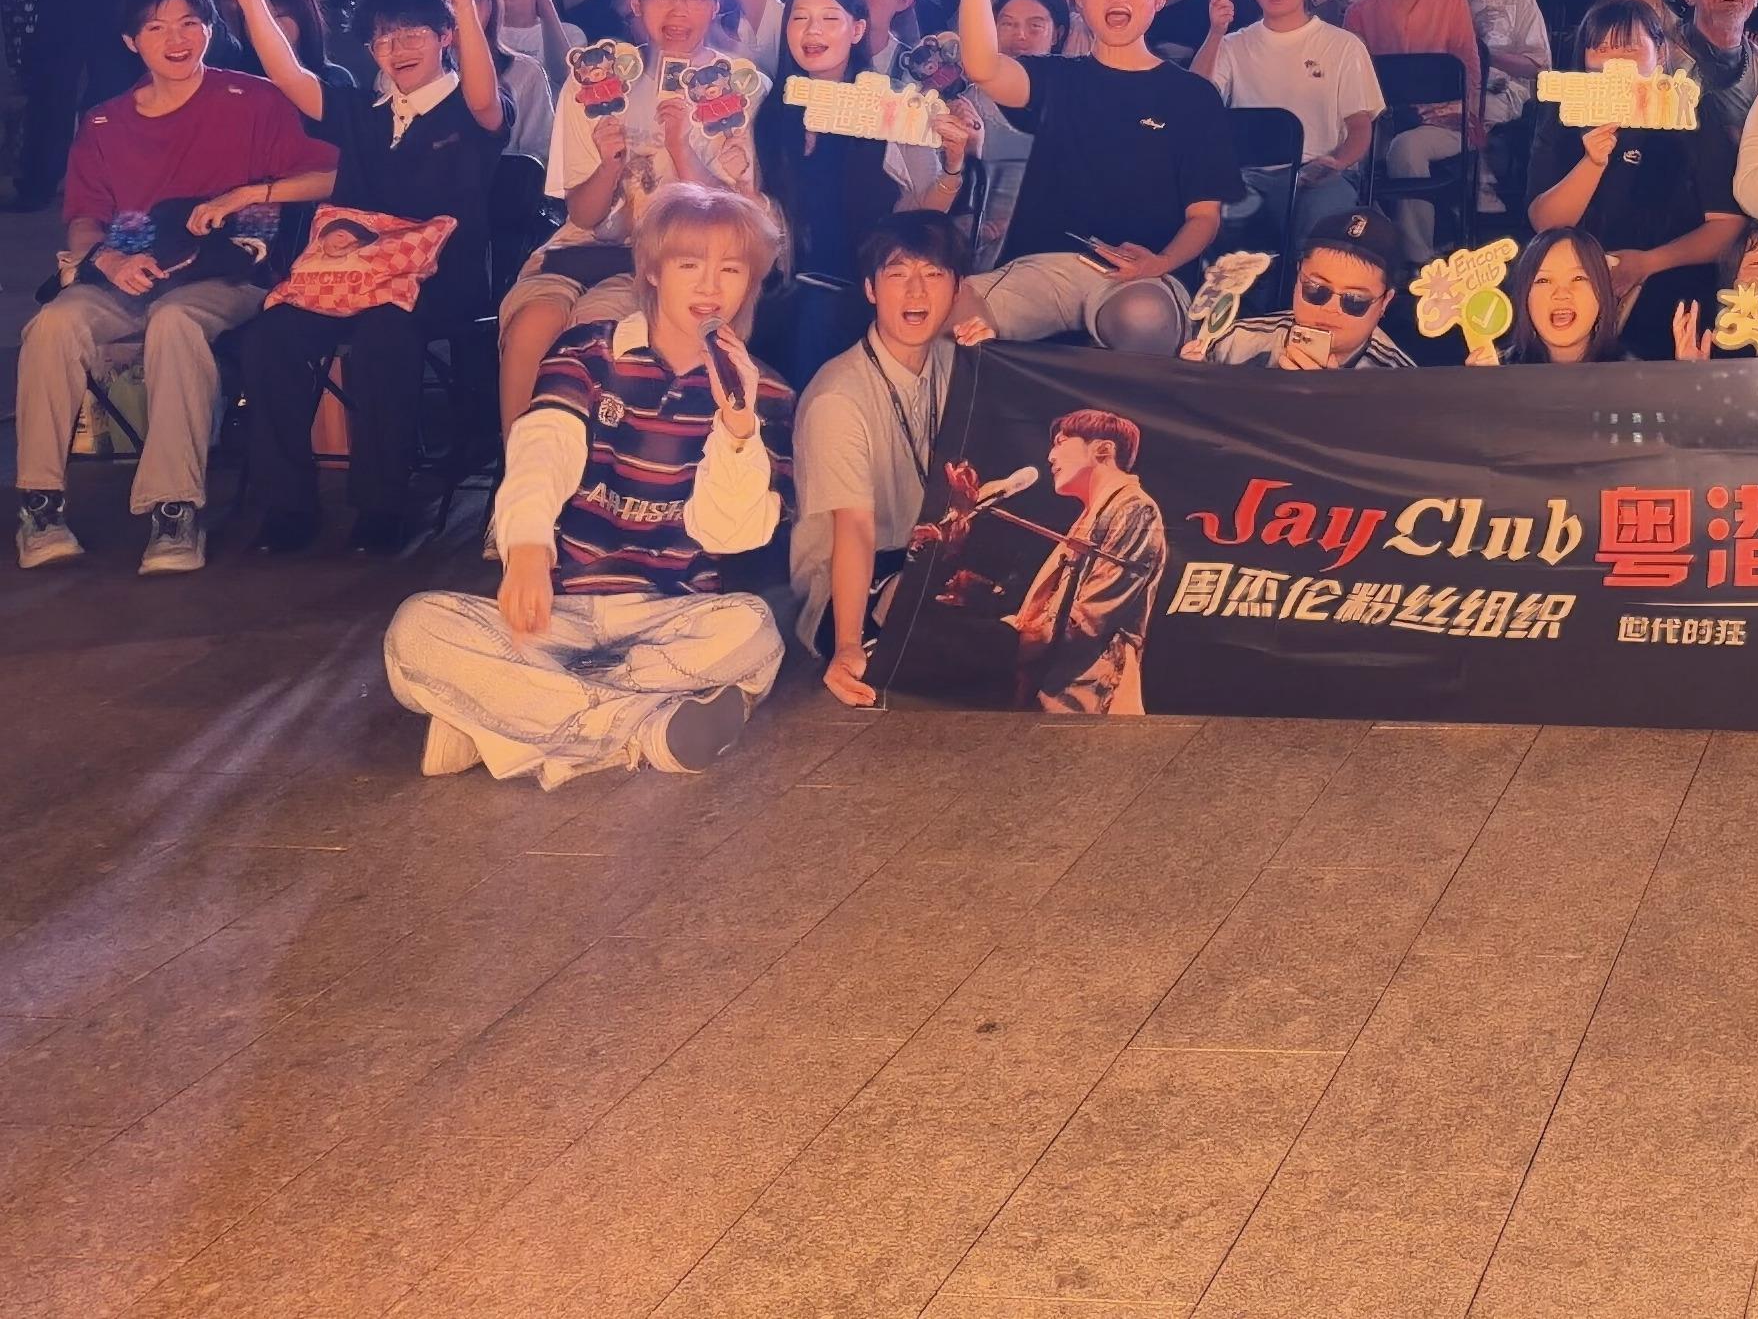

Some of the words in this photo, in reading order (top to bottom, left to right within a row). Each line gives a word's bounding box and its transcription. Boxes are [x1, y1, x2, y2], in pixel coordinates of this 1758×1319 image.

[1454, 243, 1512, 275] Encore
[1466, 264, 1500, 290] Club
[1186, 478, 1388, 572] Jay
[1383, 497, 1584, 567] Club
[1166, 562, 1578, 640] 周杰伦粉丝组织
[1617, 615, 1747, 647] 世代的狂
